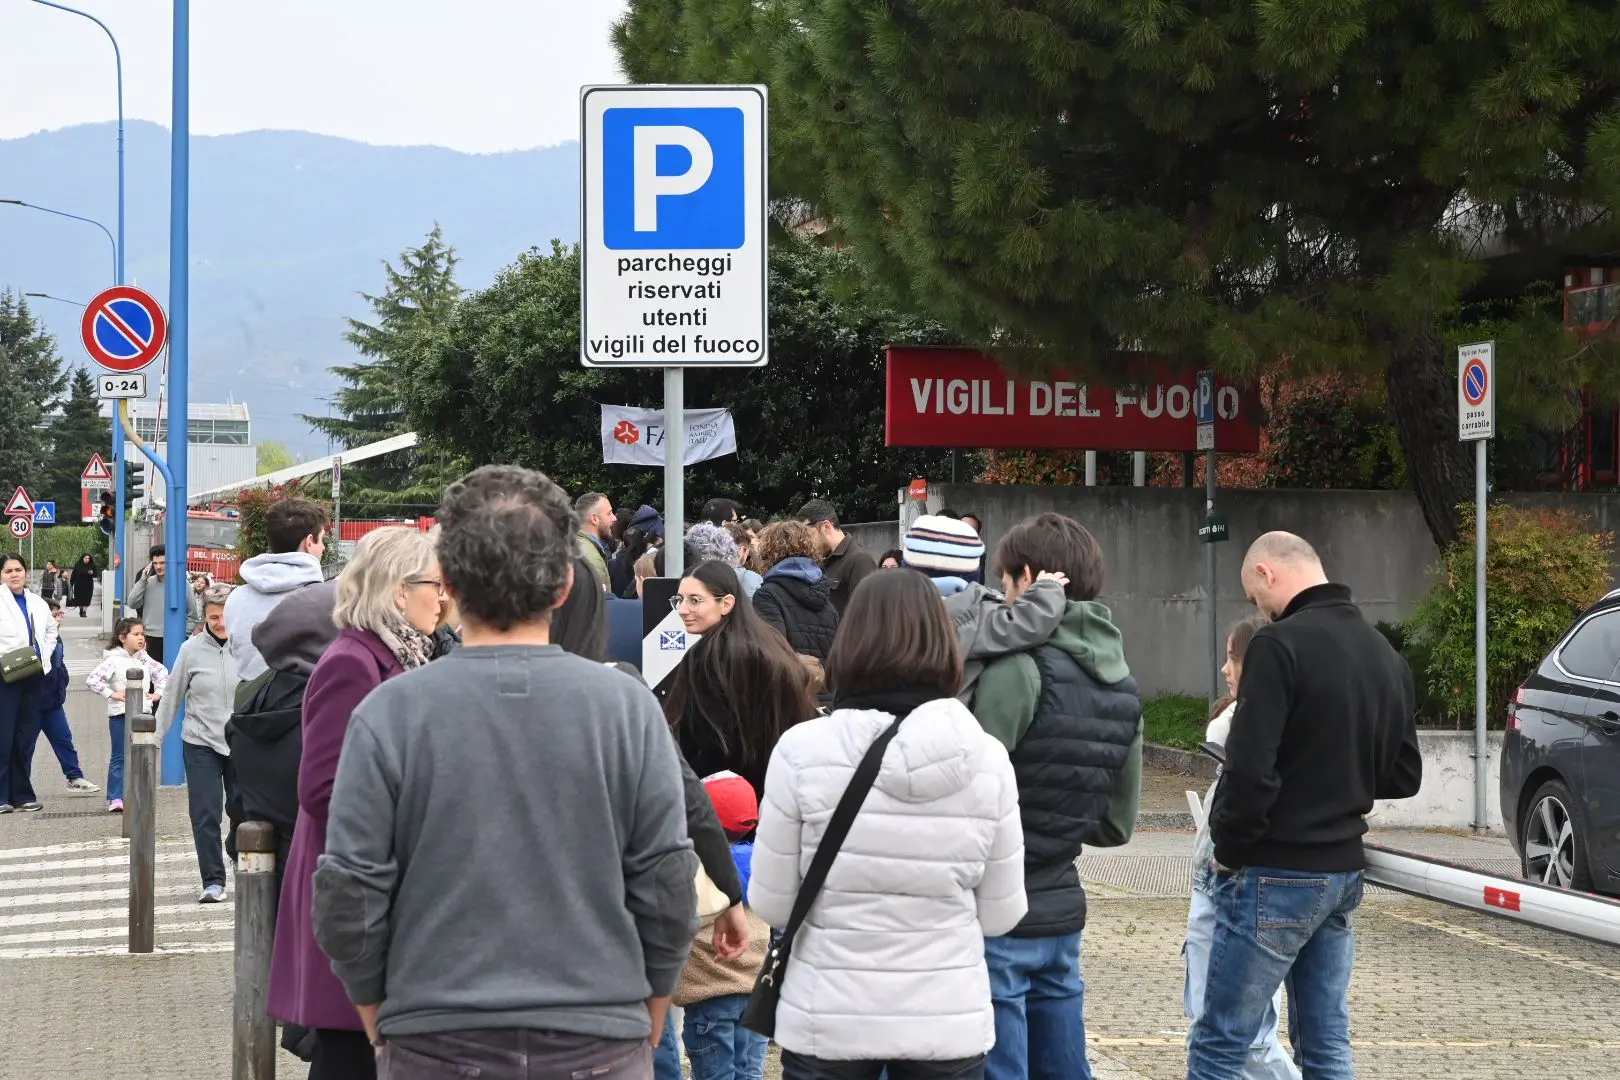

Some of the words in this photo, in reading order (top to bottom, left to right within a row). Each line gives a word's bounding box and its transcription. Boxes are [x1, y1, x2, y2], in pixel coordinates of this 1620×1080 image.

[633, 125, 714, 232] P
[617, 254, 732, 277] parcheggi
[627, 281, 721, 299] riservati
[642, 308, 707, 326] utenti
[590, 335, 644, 358] vigili
[652, 335, 686, 354] del
[693, 335, 760, 354] fuoco
[104, 380, 139, 393] 0-24
[910, 377, 1015, 416] VIGILI
[1029, 380, 1101, 417] DEL
[1115, 383, 1239, 420] FUOO
[1466, 410, 1485, 420] passo
[1461, 420, 1490, 430] carrabile
[14, 521, 27, 532] 30
